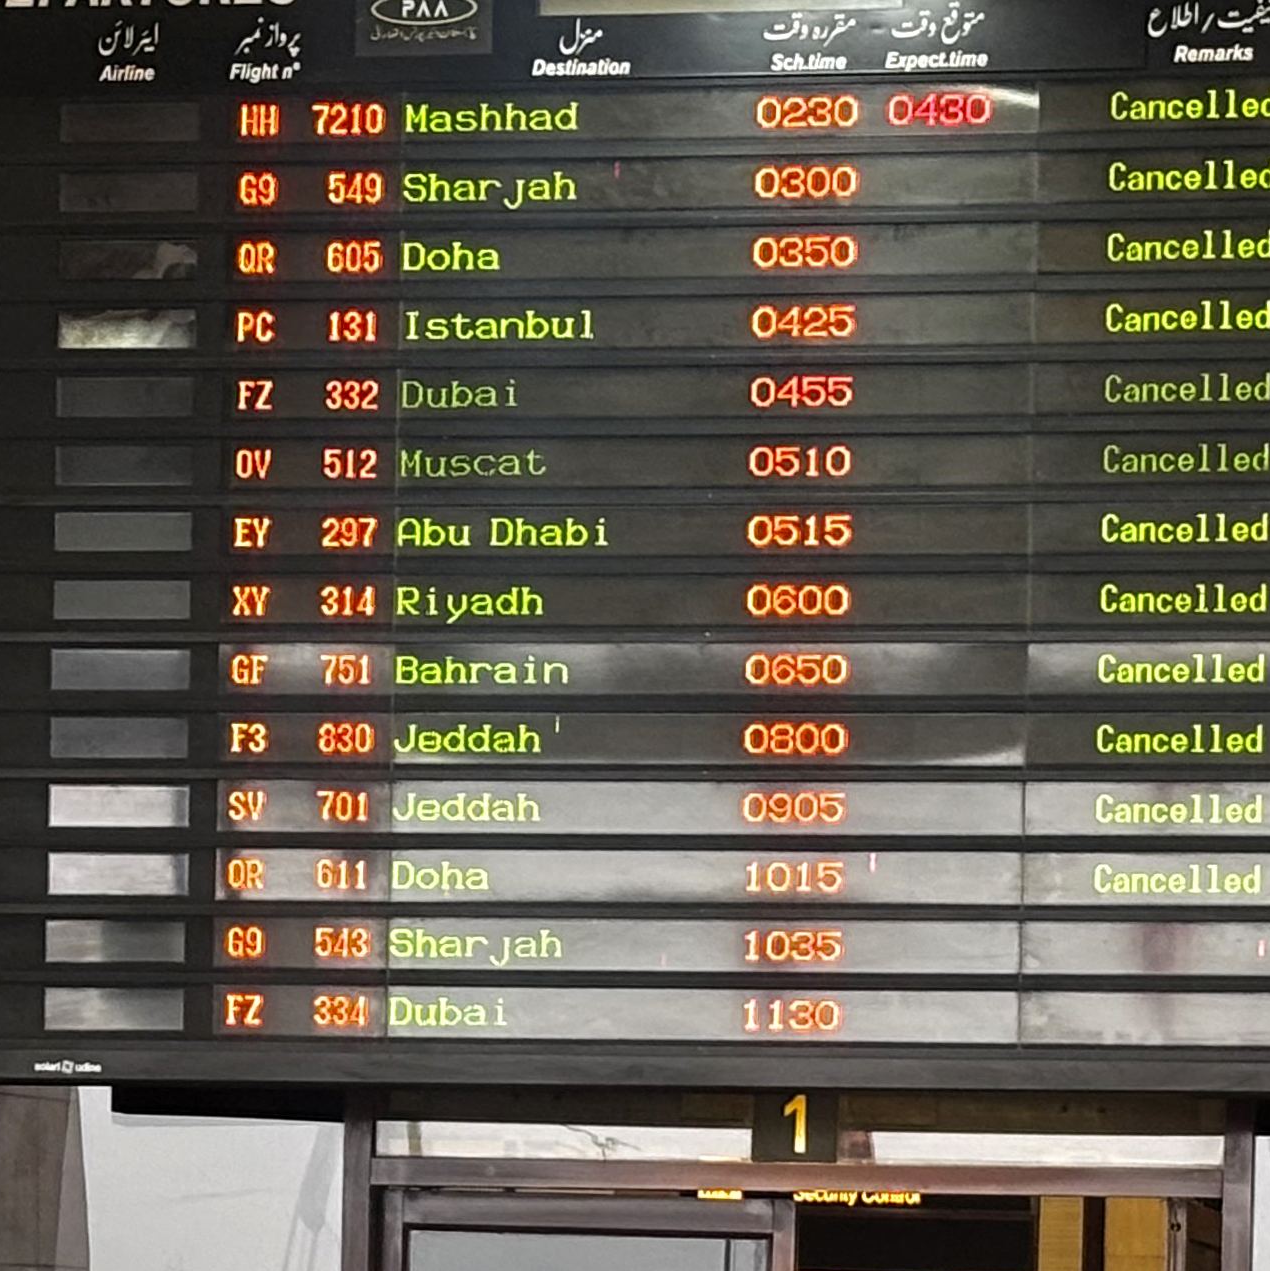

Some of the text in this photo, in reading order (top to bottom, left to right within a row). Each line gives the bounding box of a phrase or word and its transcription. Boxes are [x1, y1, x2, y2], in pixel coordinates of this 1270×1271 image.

[234, 17, 302, 57] پرواز نمبر
[559, 17, 603, 55] منزل
[763, 12, 856, 47] مقررہ وقت
[891, 10, 937, 38] وقت
[531, 58, 631, 77] Destination
[1174, 44, 1254, 64] Remarks
[99, 64, 155, 82] Airline
[230, 62, 279, 83] Flight
[238, 103, 280, 137] HH
[312, 101, 386, 137] 7210
[405, 102, 577, 133] Mashhad
[756, 94, 857, 130] 0230
[886, 92, 993, 128] 0430
[238, 171, 278, 207] G9
[326, 171, 385, 205] 549
[403, 172, 577, 208] Sharjah
[754, 165, 859, 199] 0300
[236, 240, 276, 275] QR
[325, 239, 384, 274] 605
[401, 241, 500, 271] Doha
[752, 234, 859, 270] 0350
[236, 310, 276, 343] PC
[328, 308, 377, 343] 131
[405, 309, 593, 341] Istanbul
[750, 304, 857, 340] 0425
[238, 379, 274, 411] FZ
[326, 379, 379, 411] 332
[400, 380, 518, 409] Dubai
[750, 375, 853, 408] 0455
[236, 448, 272, 479] OV
[323, 447, 377, 480] 512
[398, 448, 547, 479] Muscat
[749, 445, 851, 478] 0510
[233, 513, 1270, 549] EY 297 Abu Dhabi 0515 Cancelled
[232, 583, 1269, 623] XY 314 Riyadh 0600 Cancelled
[230, 652, 1267, 687] GF 751 Bahrain 0650 Cancelled
[230, 721, 1264, 756] F3 830 Jeddah 0800 Cancelled
[228, 790, 1265, 825] SV 701 Jeddah 0905 Cancelled
[226, 857, 1263, 894] QR 611 Doha 1015 Cancelled
[224, 925, 844, 966] G9 543 Sharjah 1035
[225, 992, 842, 1034] FZ 334 Dubai 1130
[784, 1094, 807, 1154] 1
